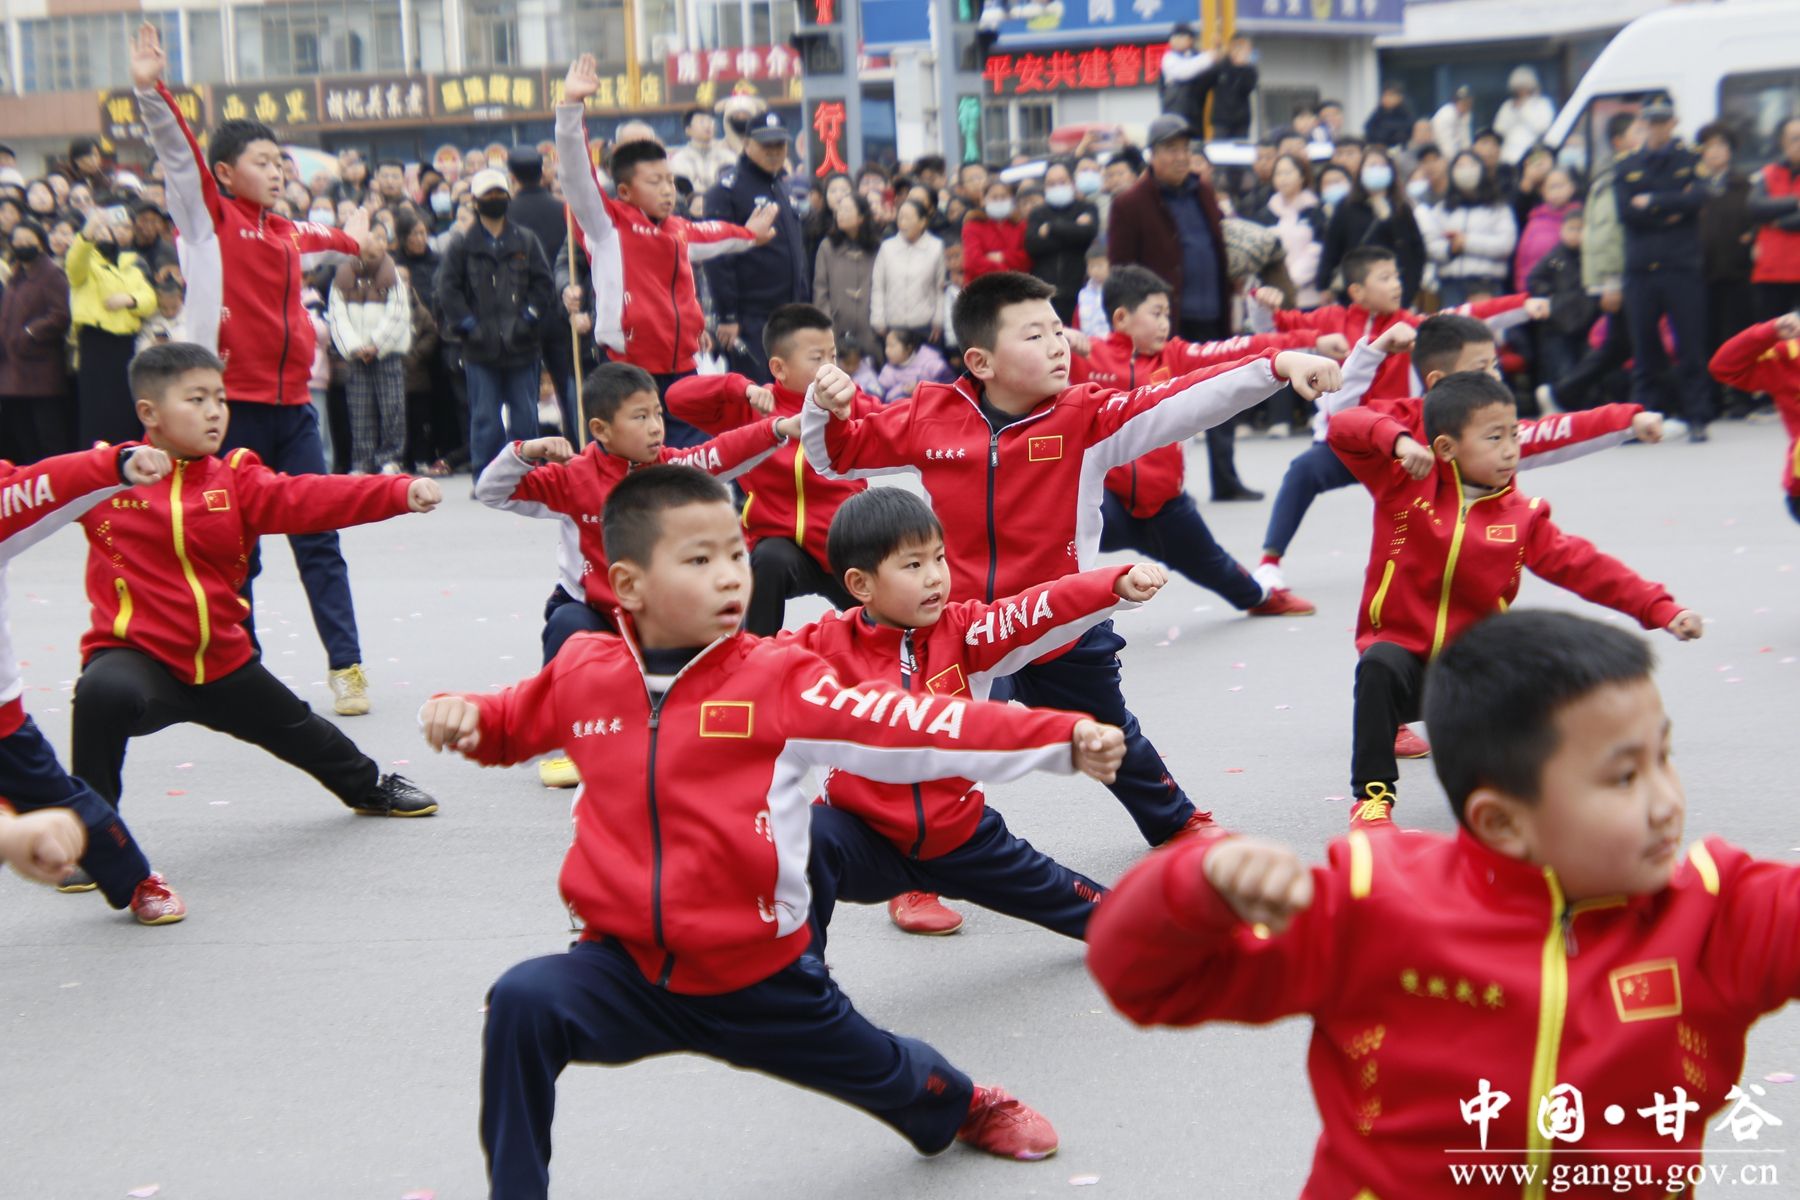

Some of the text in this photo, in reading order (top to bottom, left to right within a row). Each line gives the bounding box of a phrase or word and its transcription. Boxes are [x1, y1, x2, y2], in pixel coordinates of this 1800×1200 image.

[814, 101, 848, 177] 行人
[0, 473, 55, 518] INA
[800, 674, 967, 739] CHINA
